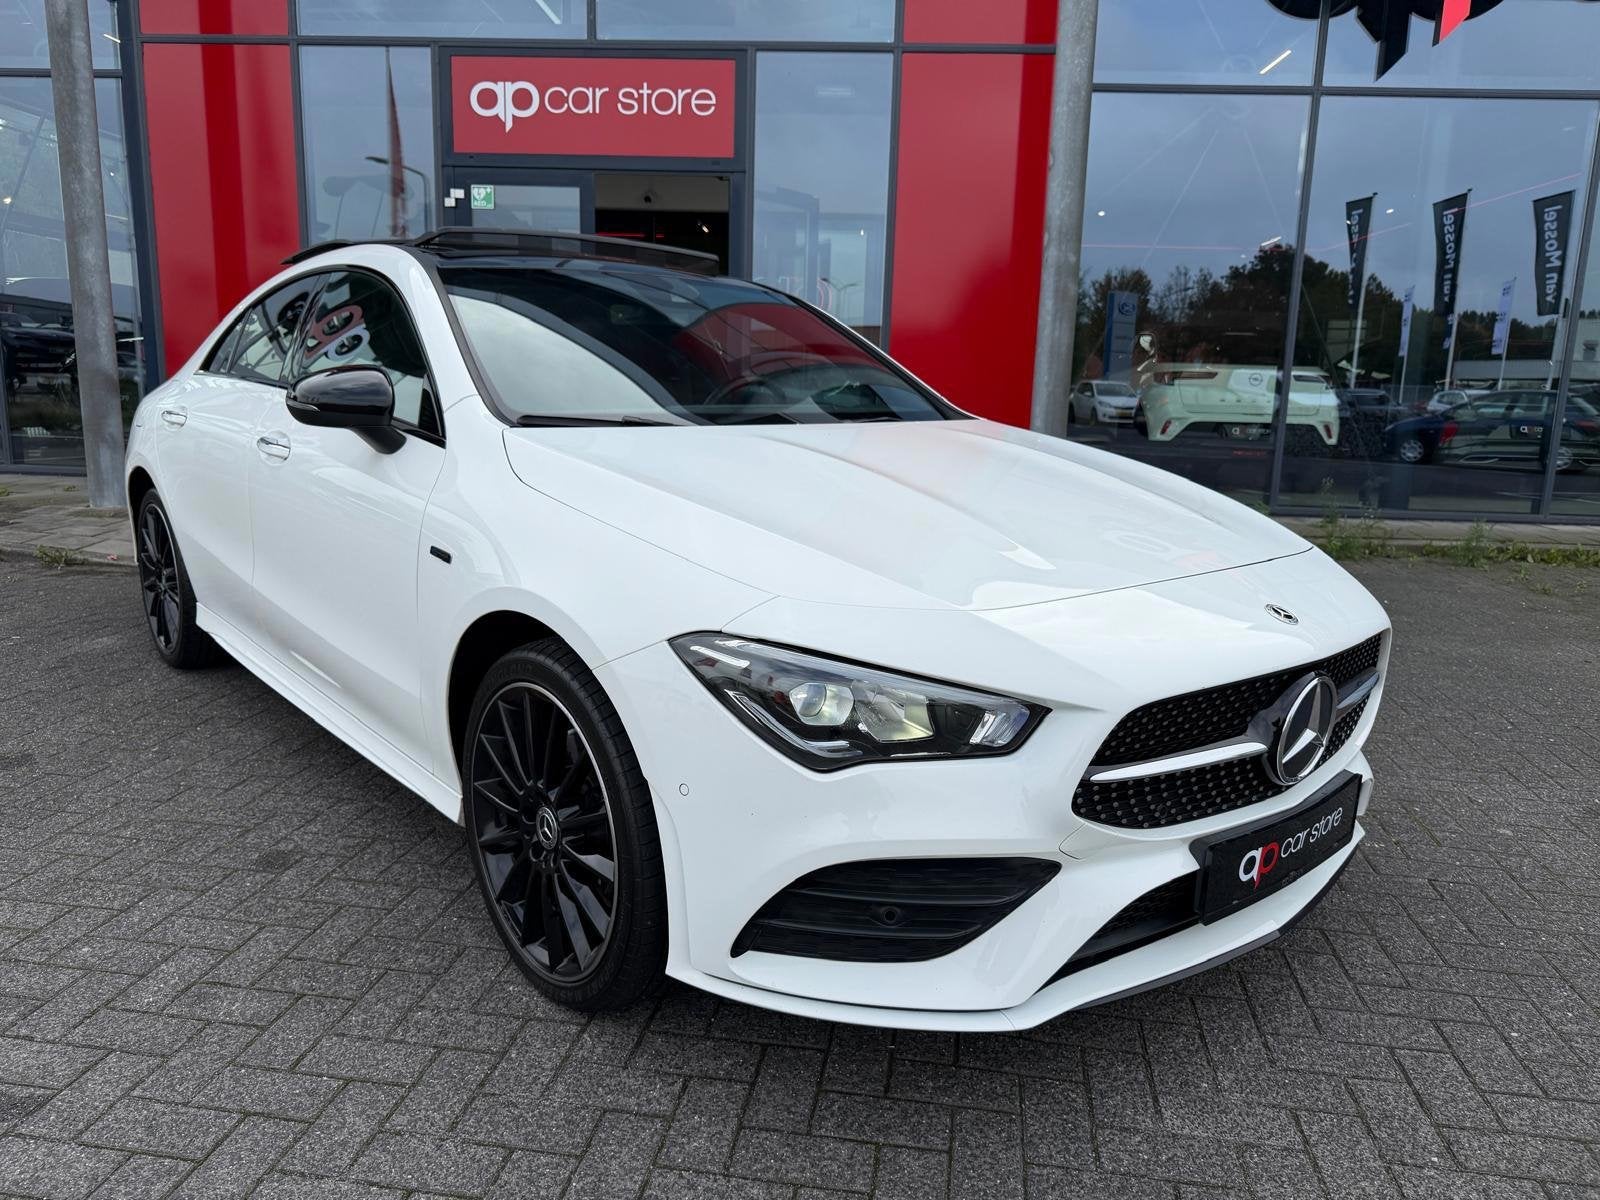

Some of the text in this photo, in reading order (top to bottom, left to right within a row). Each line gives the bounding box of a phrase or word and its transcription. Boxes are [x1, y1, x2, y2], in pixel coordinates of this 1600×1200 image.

[469, 80, 717, 133] ap car store
[1238, 841, 1281, 890] ap
[1280, 827, 1310, 858] car
[1309, 807, 1343, 843] store
